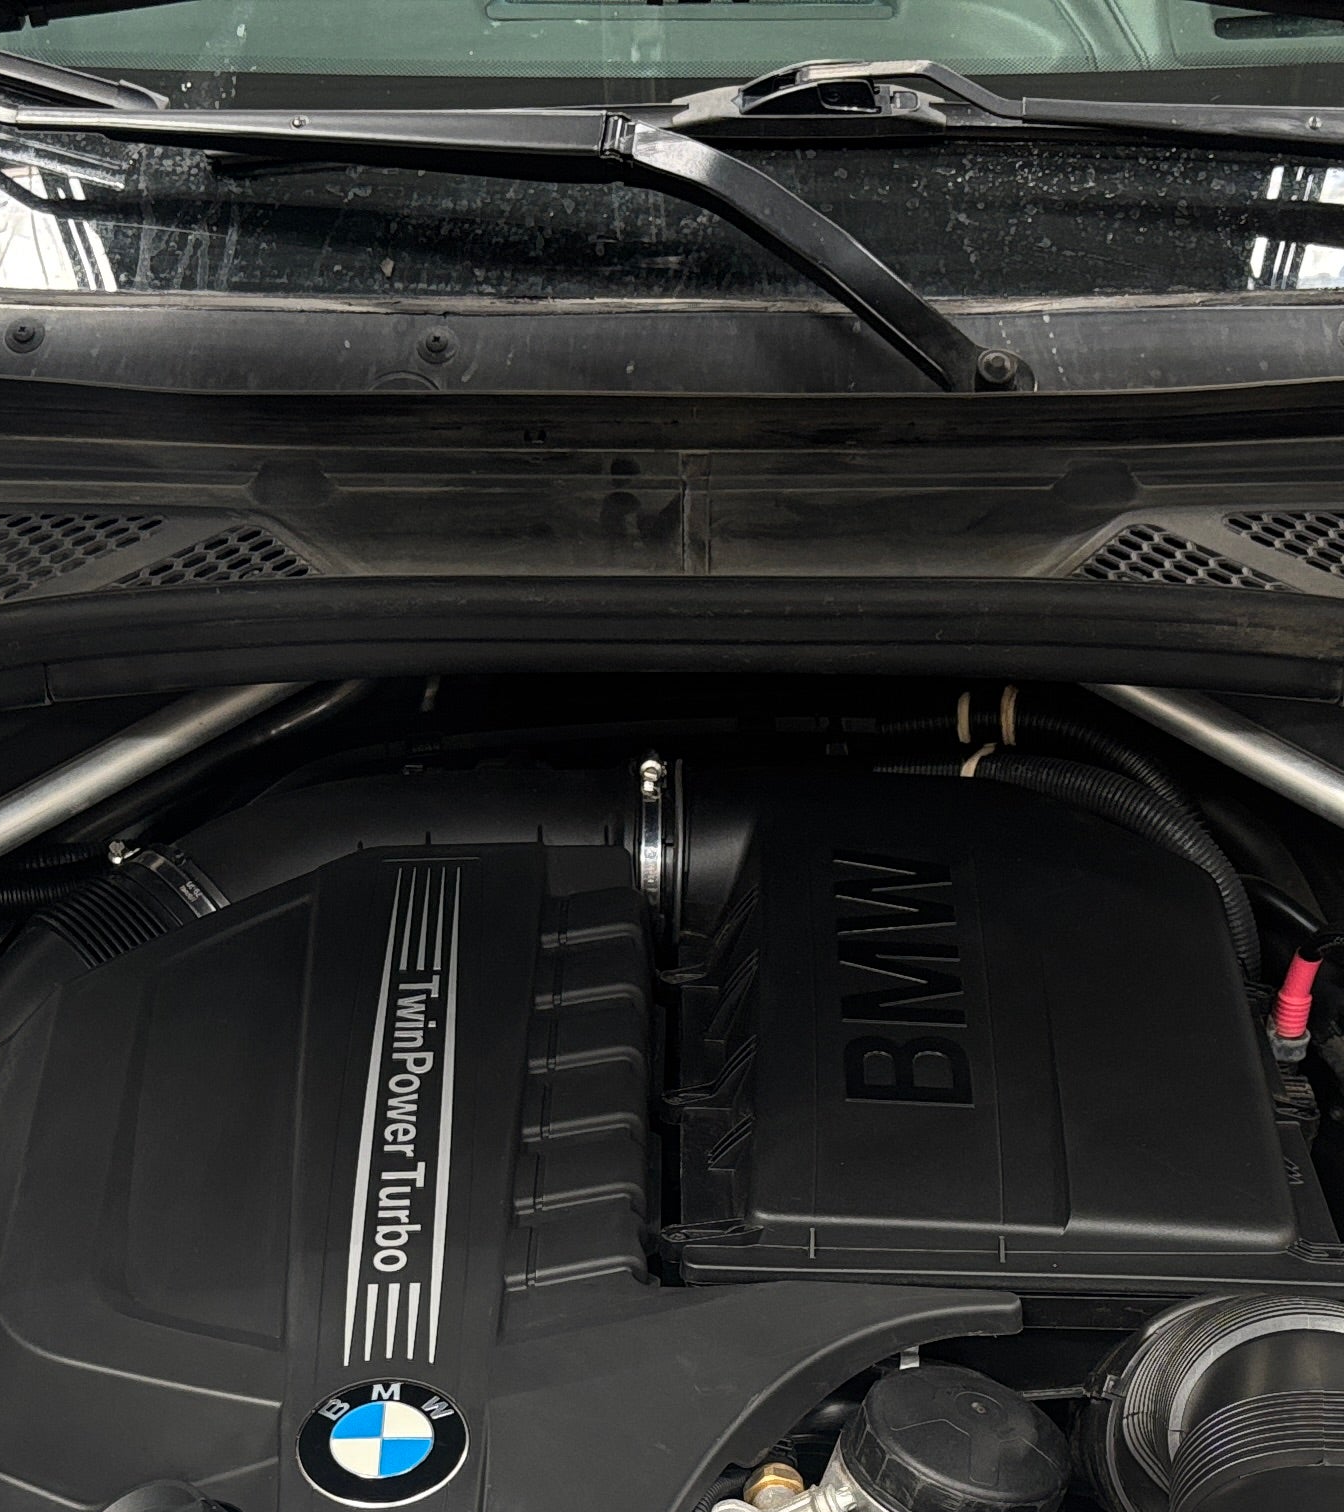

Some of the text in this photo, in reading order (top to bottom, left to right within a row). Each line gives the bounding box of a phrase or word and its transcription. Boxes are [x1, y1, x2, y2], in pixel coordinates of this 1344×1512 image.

[832, 851, 976, 1109] BMW
[372, 974, 441, 1273] TwinPower Turbo
[318, 1382, 455, 1421] BMW
